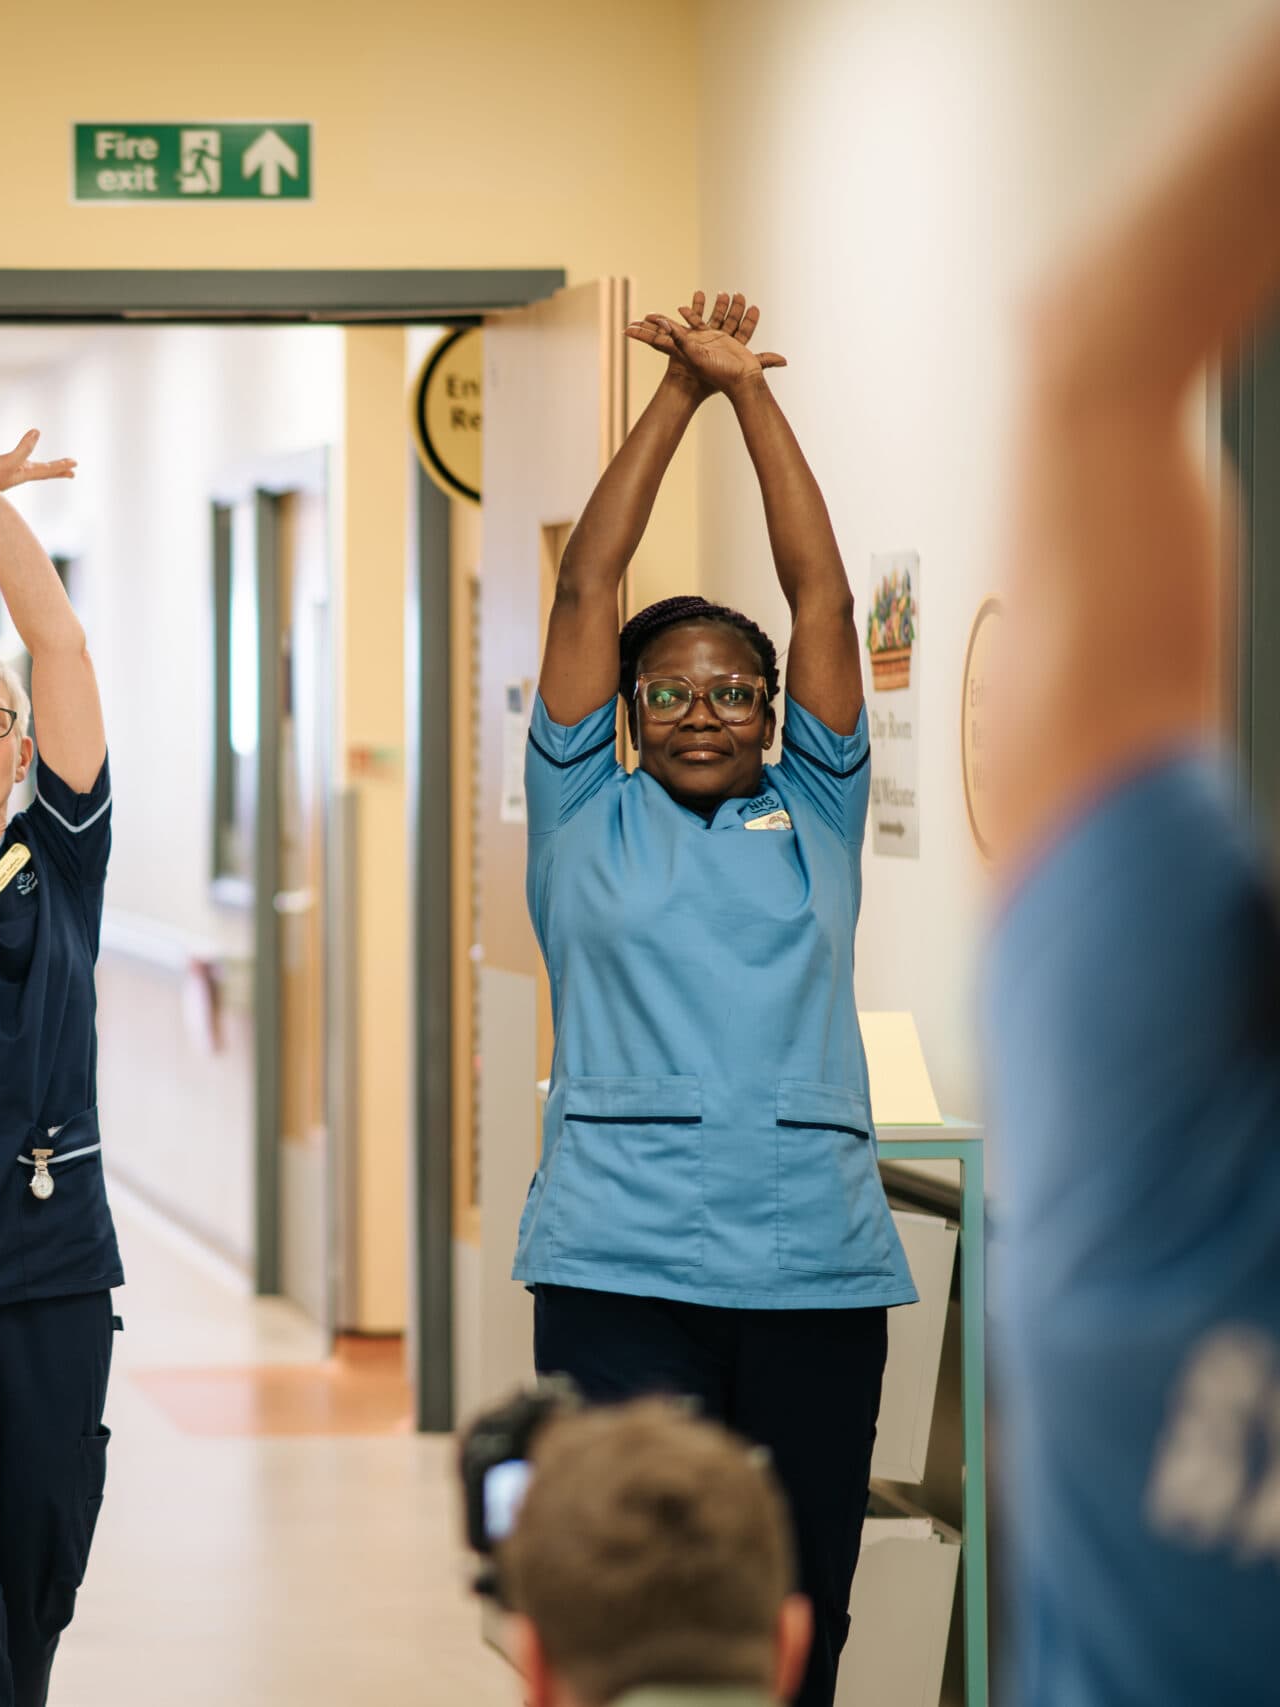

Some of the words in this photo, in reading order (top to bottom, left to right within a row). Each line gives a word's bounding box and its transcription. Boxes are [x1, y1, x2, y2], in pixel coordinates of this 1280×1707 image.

[95, 130, 159, 160] Fire
[96, 163, 159, 192] exit
[750, 795, 775, 810] NHS
